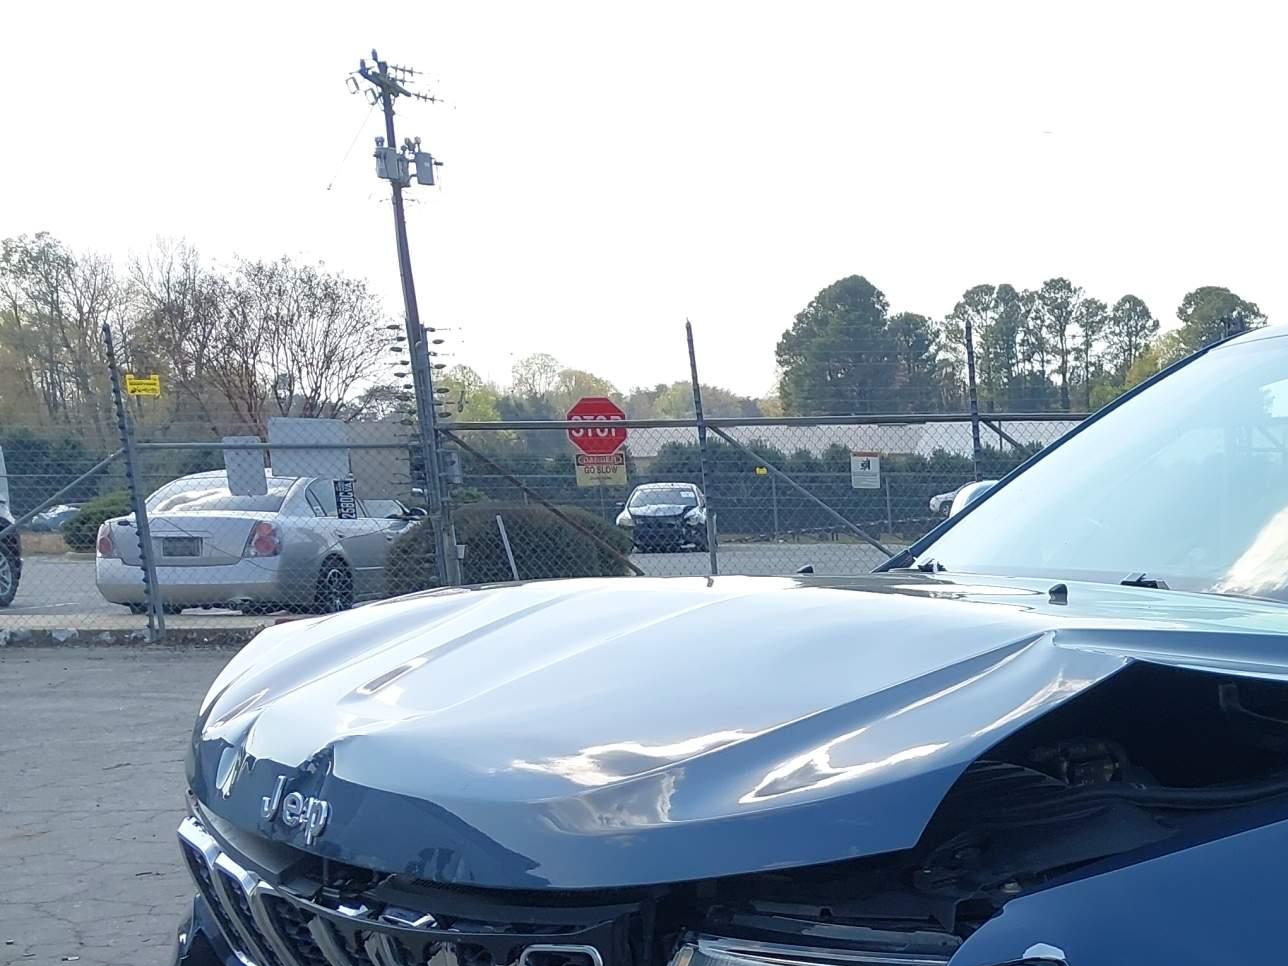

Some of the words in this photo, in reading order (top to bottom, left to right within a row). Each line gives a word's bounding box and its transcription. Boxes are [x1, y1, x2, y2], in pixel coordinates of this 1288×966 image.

[571, 415, 622, 437] STOP
[584, 466, 595, 474] GO
[597, 466, 618, 474] SLOW
